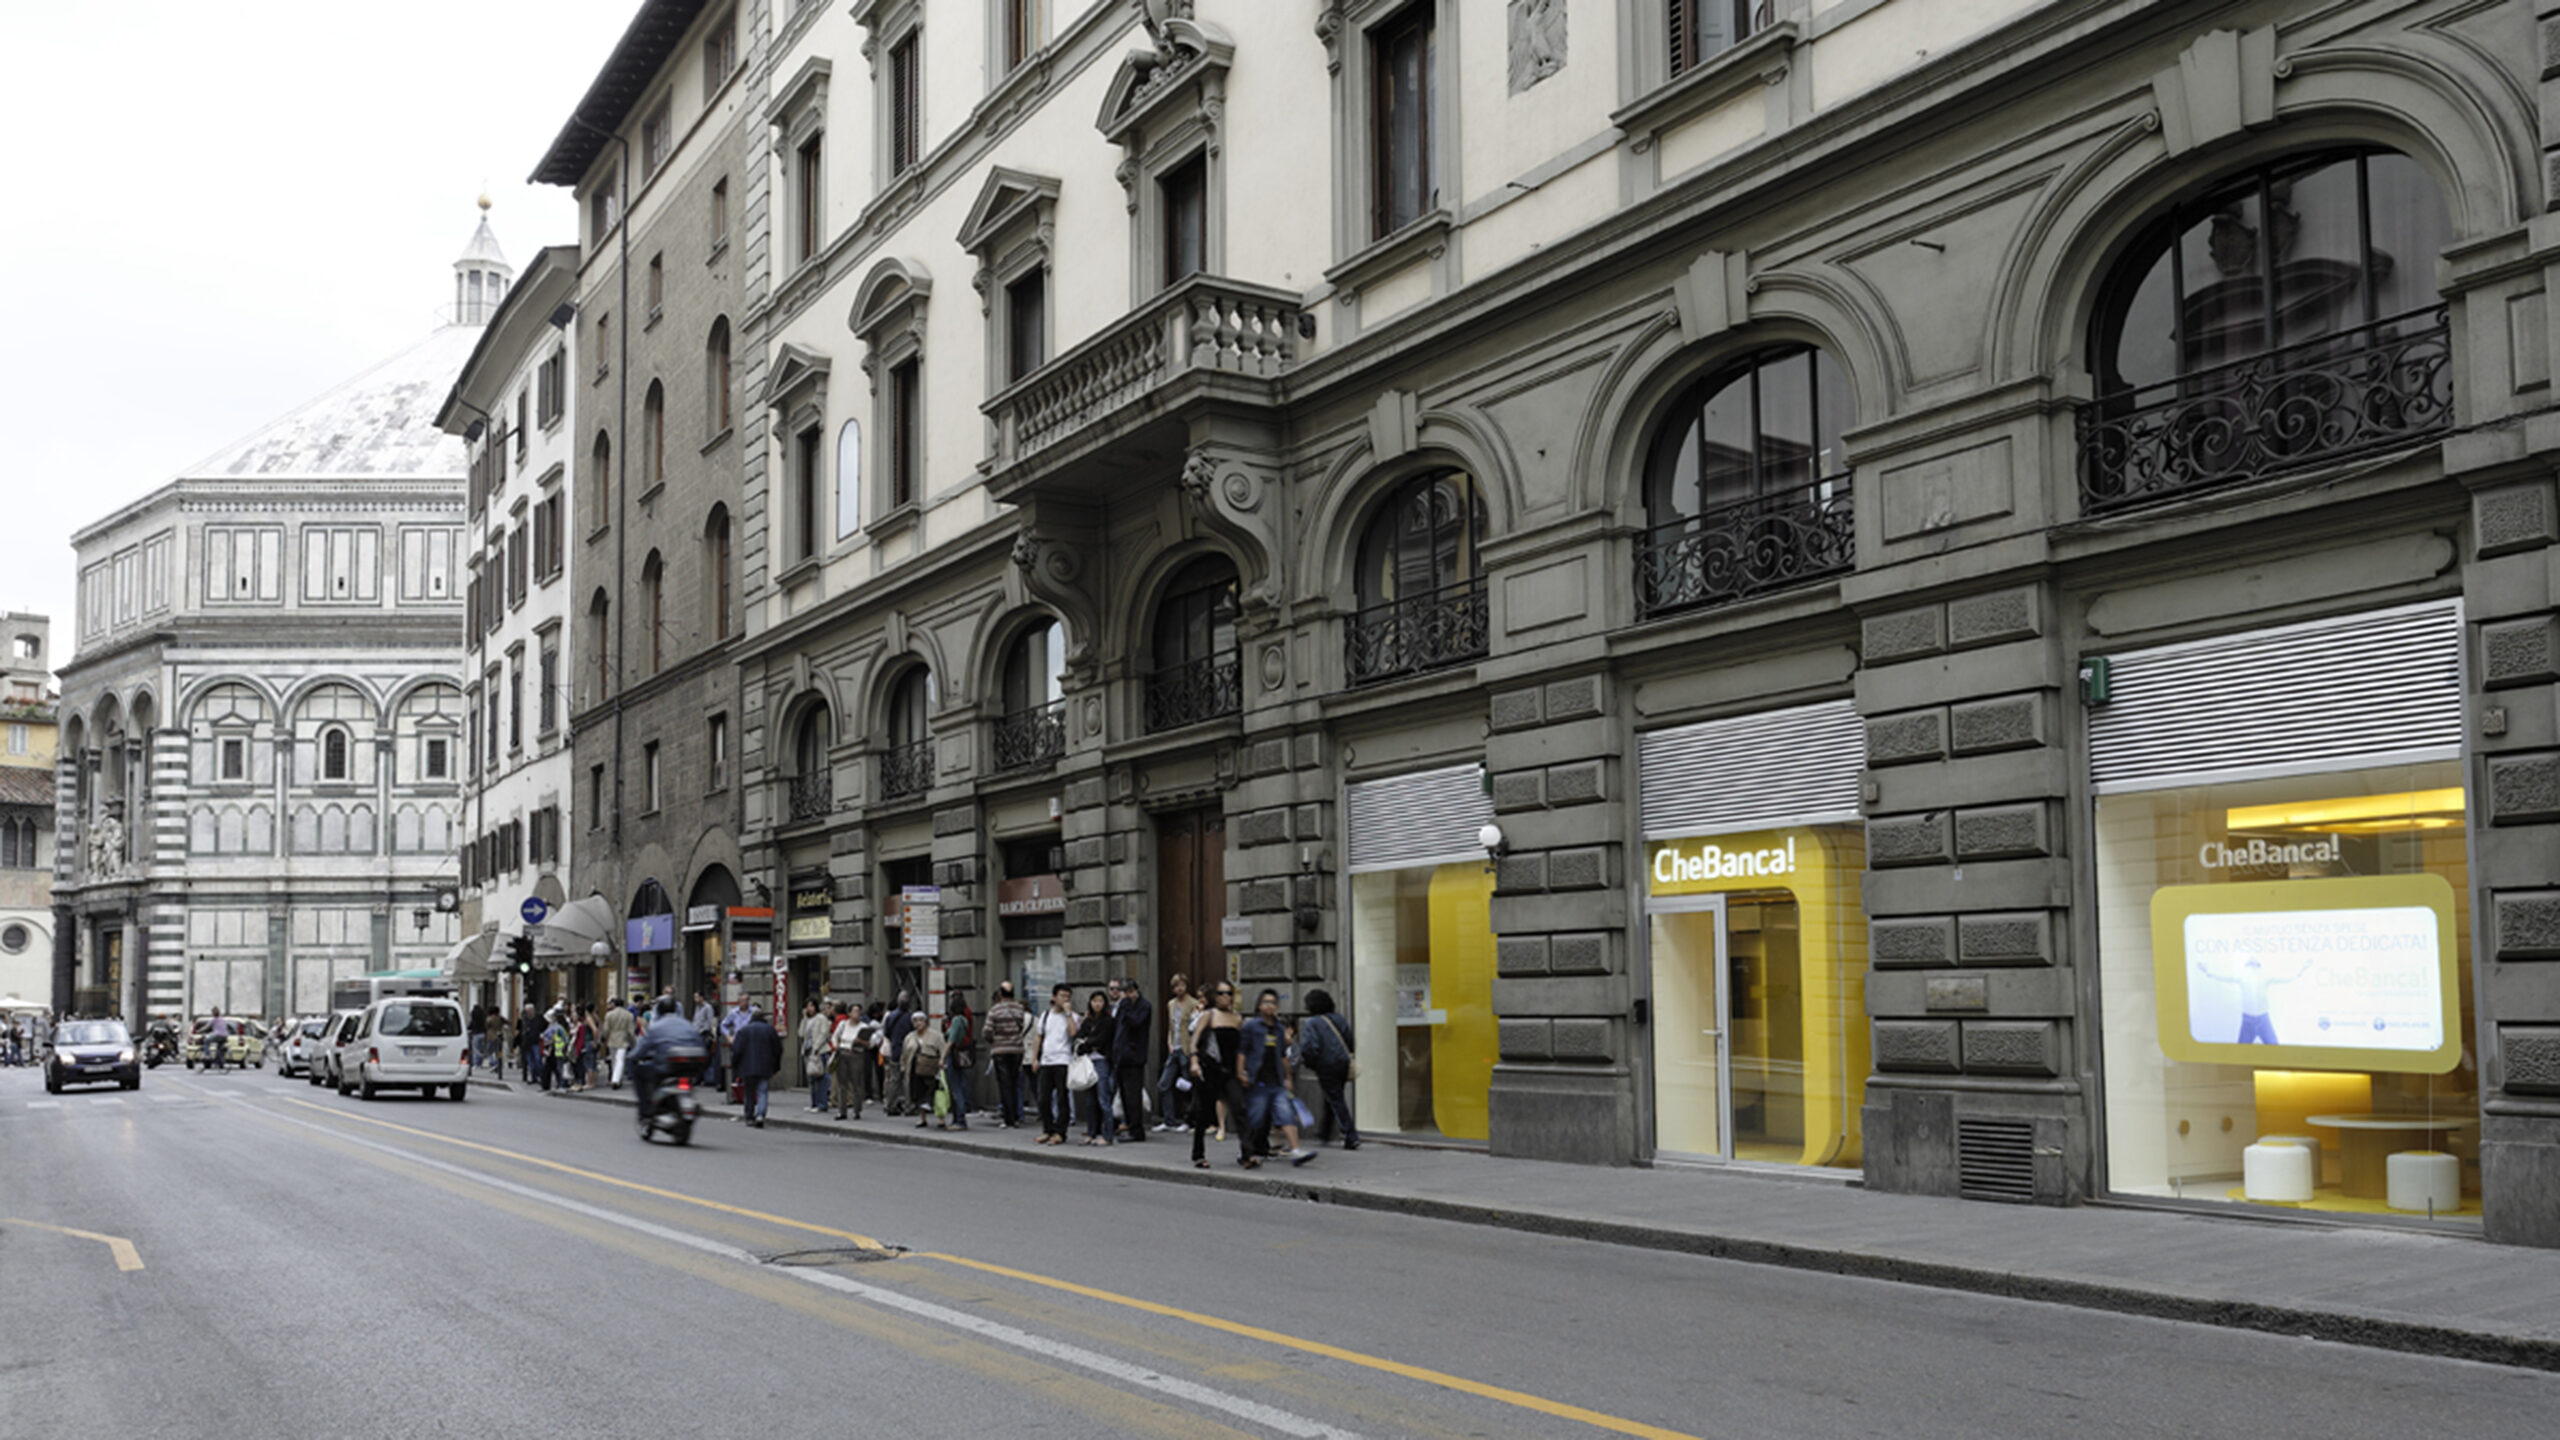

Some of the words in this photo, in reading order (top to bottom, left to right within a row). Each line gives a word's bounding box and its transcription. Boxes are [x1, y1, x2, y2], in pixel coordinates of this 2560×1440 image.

[1654, 836, 1796, 883] CheBanca!
[2198, 833, 2341, 870] CheBanca!
[2194, 937, 2229, 954] CON
[2231, 934, 2334, 954] ASSISTENZA
[2336, 933, 2428, 952] DEDICATA!
